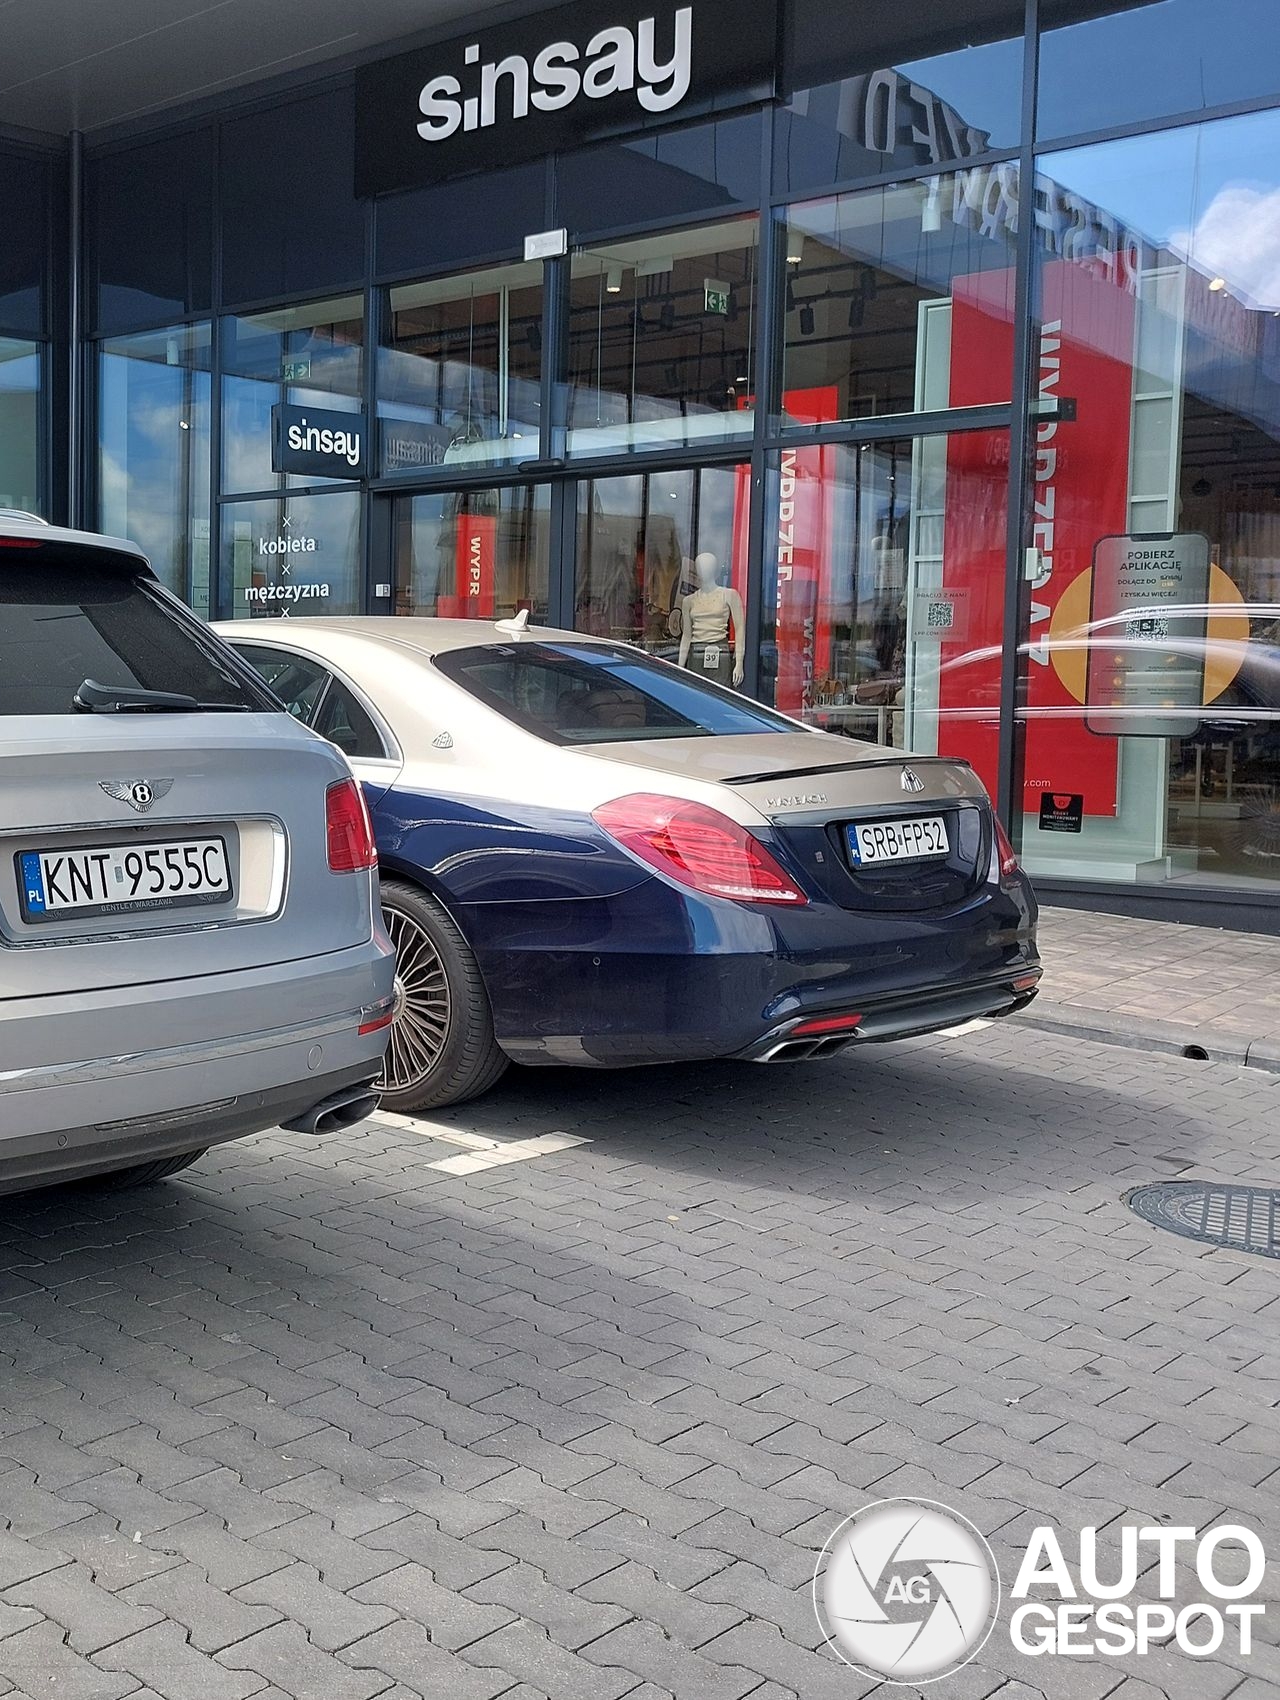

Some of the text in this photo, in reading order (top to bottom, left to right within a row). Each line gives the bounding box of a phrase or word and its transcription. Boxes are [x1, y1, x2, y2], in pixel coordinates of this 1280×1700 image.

[417, 6, 692, 141] sinsay
[288, 418, 360, 466] sinsay
[259, 536, 316, 555] kobieta
[1127, 550, 1175, 560] POBIERZ
[470, 536, 481, 597] WYPR
[1119, 561, 1182, 572] APLIKACJĘ
[245, 582, 329, 602] mężczyzna
[766, 793, 828, 808] MAYBACH
[861, 821, 945, 860] SRB FP52
[852, 848, 860, 858] PL
[43, 845, 223, 905] KNT 9555C
[28, 890, 43, 903] PL
[100, 897, 173, 912] BENTLEY WARSZAWA
